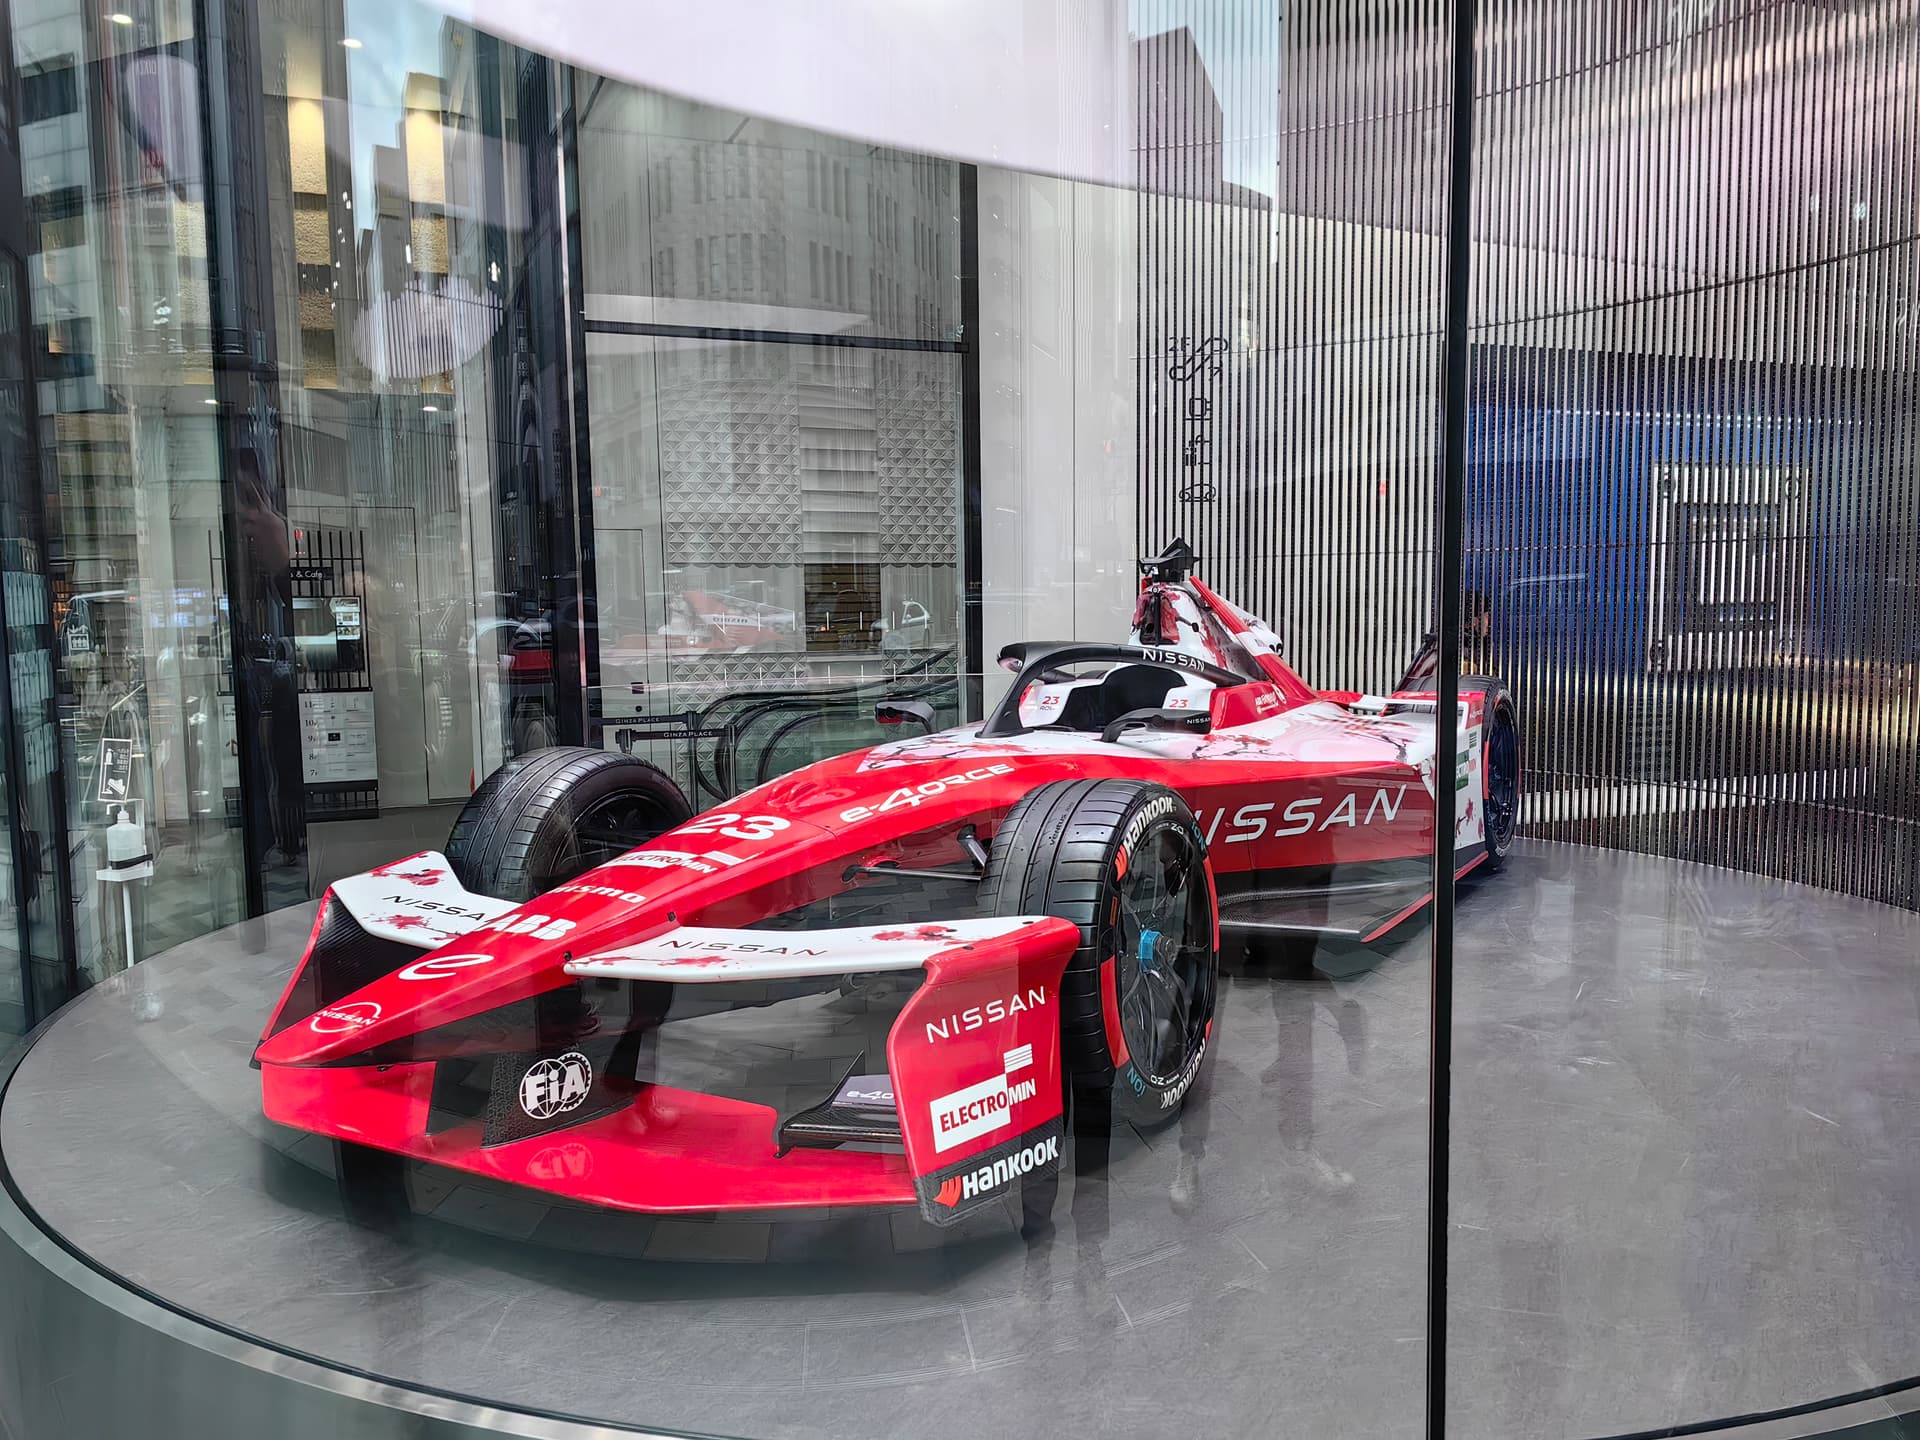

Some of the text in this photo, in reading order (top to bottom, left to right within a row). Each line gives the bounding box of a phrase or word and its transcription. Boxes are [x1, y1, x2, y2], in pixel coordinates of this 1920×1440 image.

[1168, 336, 1191, 352] 2F
[1142, 648, 1205, 673] NISSAN
[1041, 695, 1060, 705] 23
[1168, 698, 1189, 709] 23
[668, 813, 792, 841] 23
[547, 885, 647, 904] nismo
[491, 913, 578, 941] ABB
[658, 939, 829, 957] NISSAN
[318, 1009, 376, 1026] NISSAN
[926, 985, 1046, 1044] NISSAN
[939, 1078, 1037, 1134] ELECTROMIN
